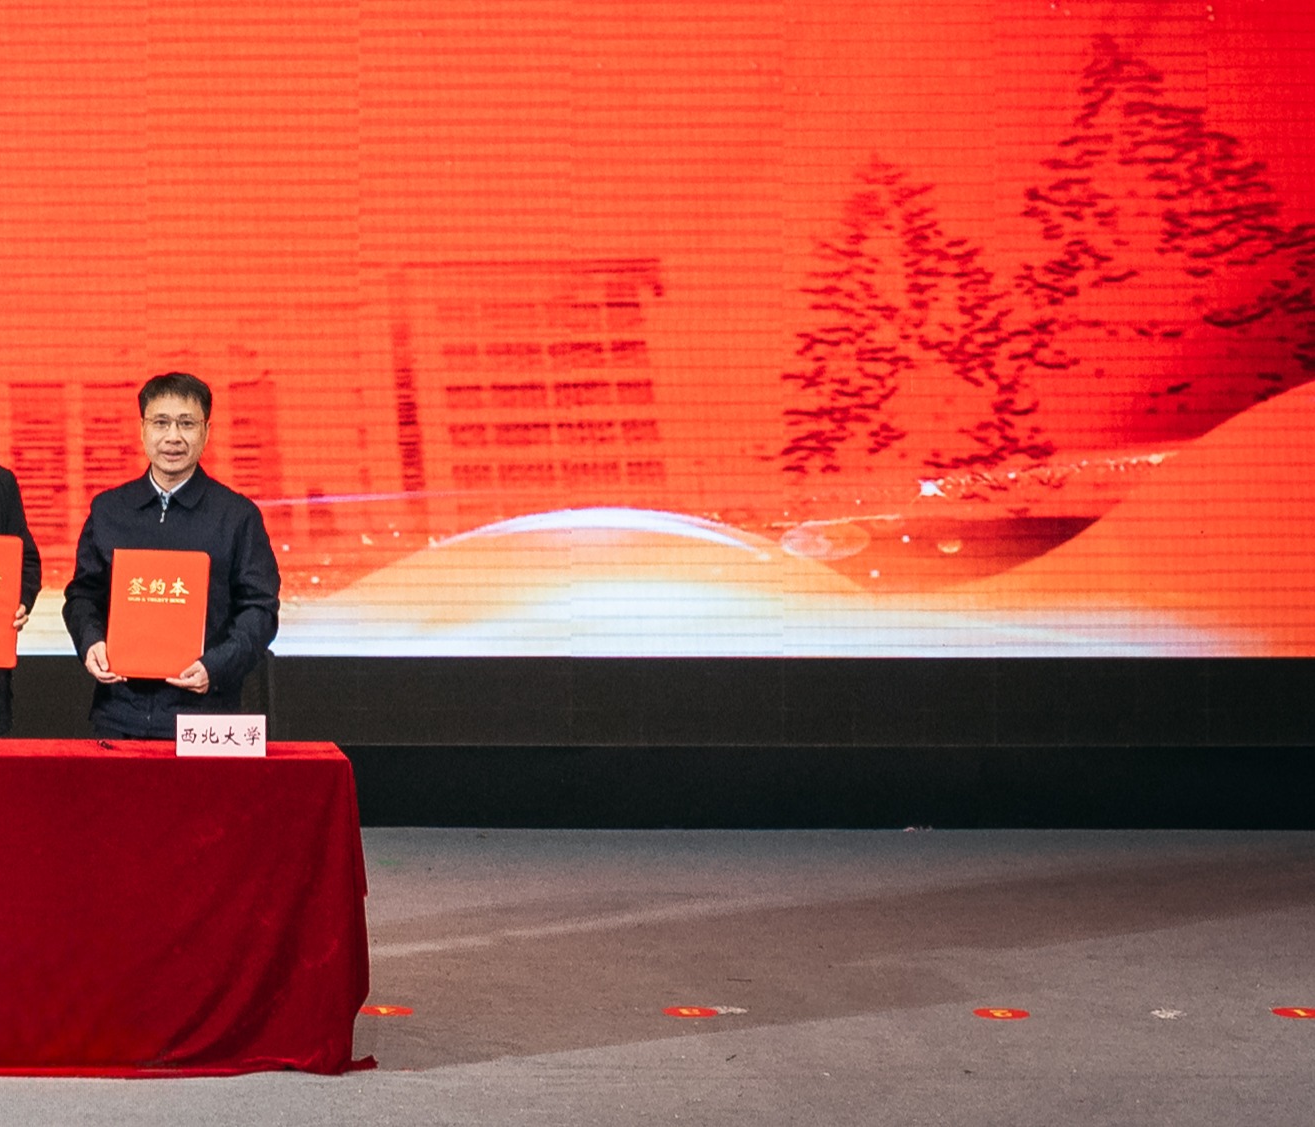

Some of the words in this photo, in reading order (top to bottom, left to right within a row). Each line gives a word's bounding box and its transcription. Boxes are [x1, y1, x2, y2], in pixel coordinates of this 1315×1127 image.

[127, 577, 189, 597] 签约本
[181, 726, 261, 746] 西北大学
